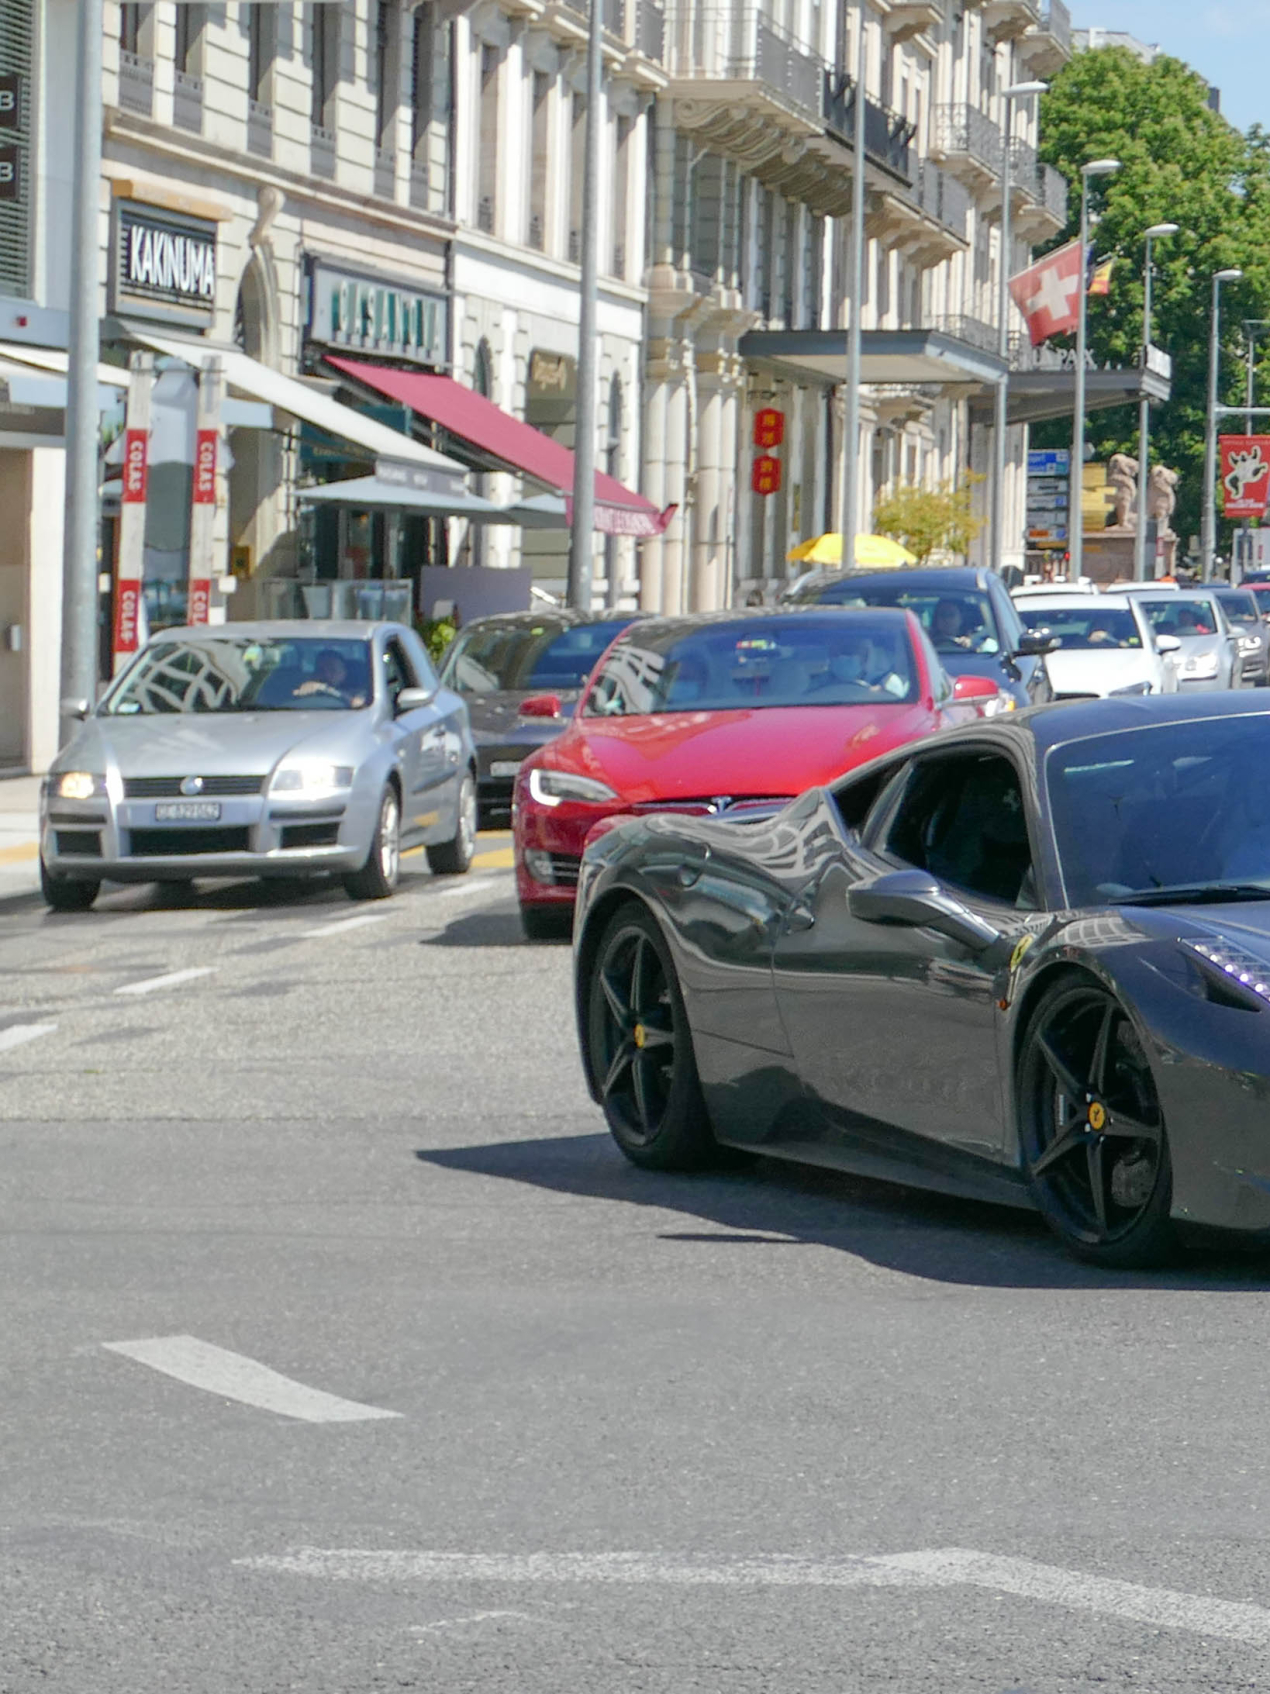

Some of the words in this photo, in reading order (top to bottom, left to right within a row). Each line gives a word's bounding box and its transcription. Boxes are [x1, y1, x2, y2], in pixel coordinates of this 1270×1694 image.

[131, 225, 214, 297] KAKINUMA
[128, 440, 144, 492] COLAS
[198, 441, 213, 491] COLAS
[120, 590, 136, 643] COLAS
[192, 590, 207, 625] COL
